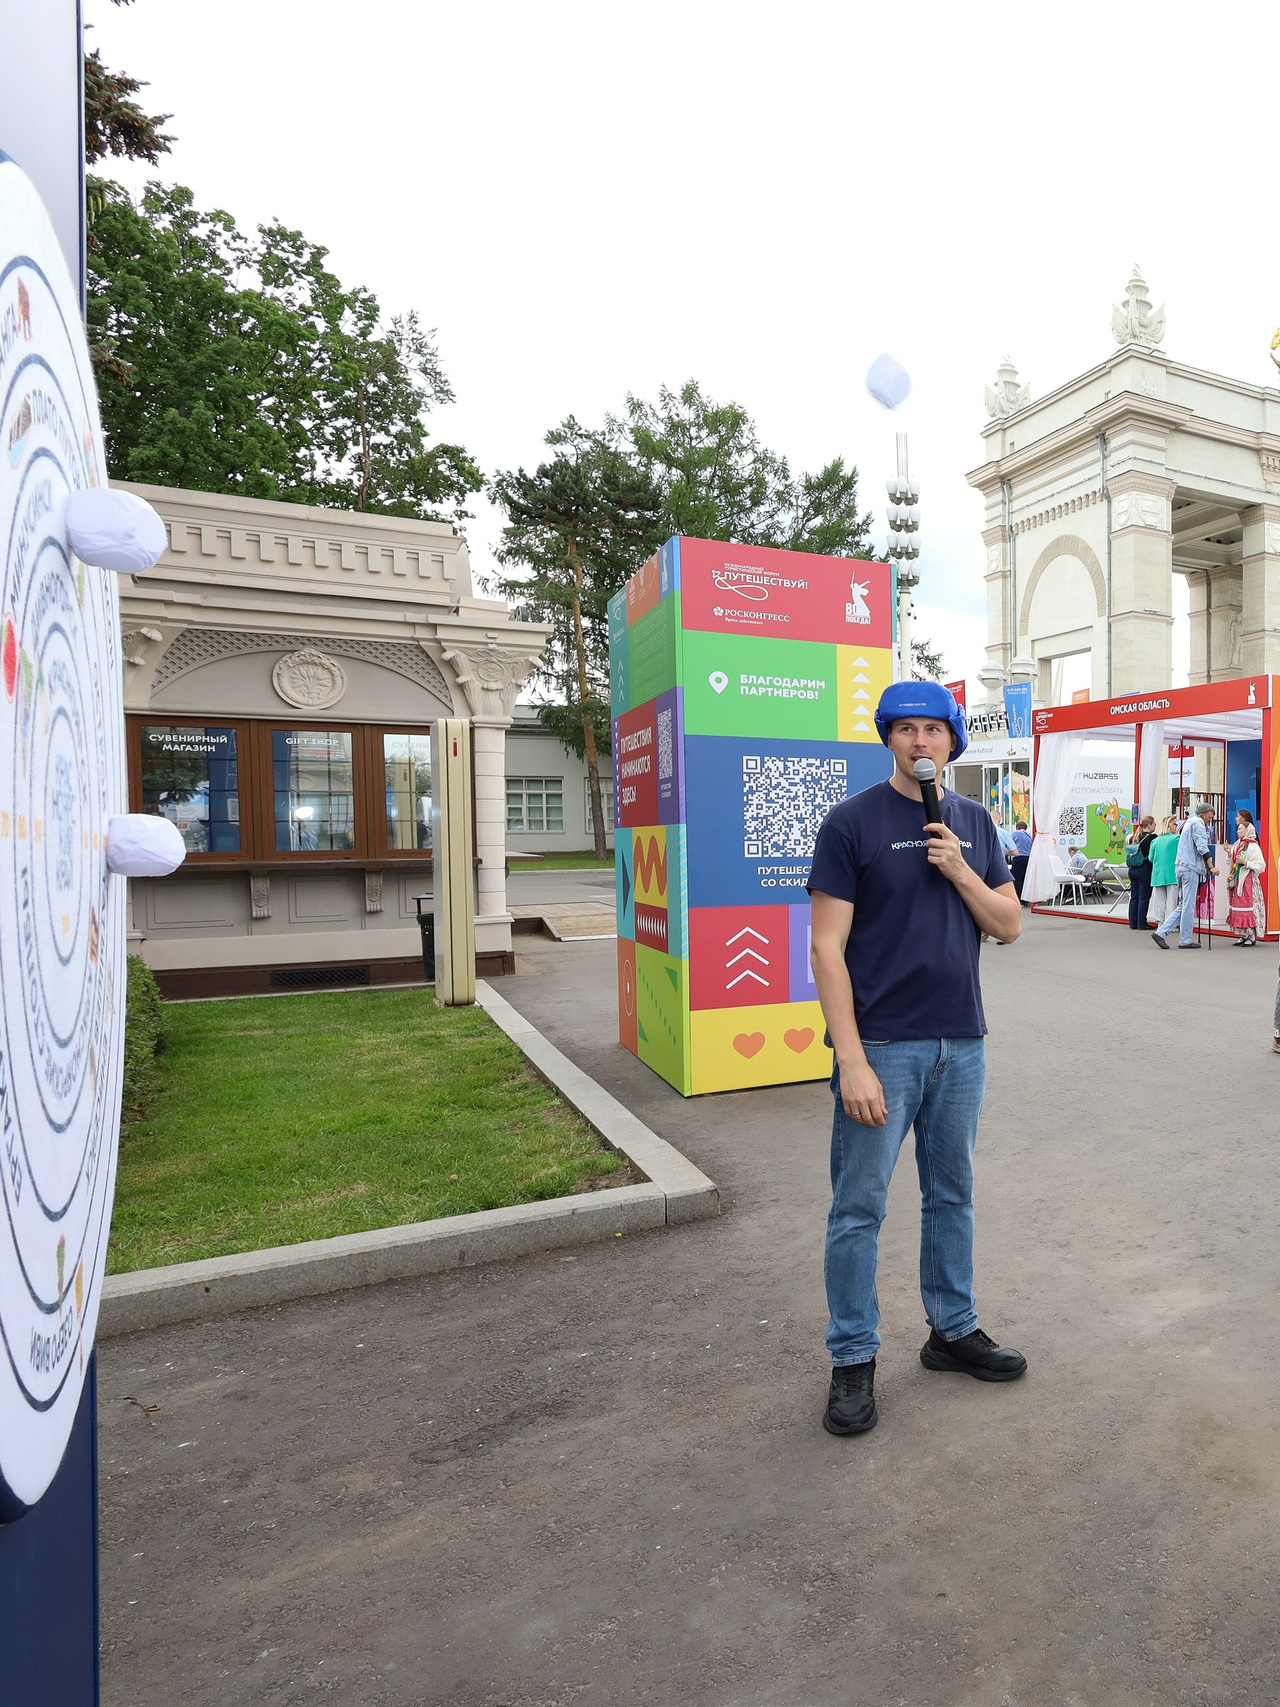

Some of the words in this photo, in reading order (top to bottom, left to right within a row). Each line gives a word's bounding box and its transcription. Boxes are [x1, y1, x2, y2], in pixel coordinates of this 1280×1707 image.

[724, 572, 809, 590] ПУТЕШЕСТВУЙ!
[725, 608, 791, 623] РОСКОНГРЕСС
[845, 616, 872, 625] ПОБЕДА!
[740, 674, 826, 690] БЛАГОДАРИМ
[740, 686, 819, 700] ПАРТНЕРОВ!
[1110, 703, 1137, 715] ОМСКАЯ
[1138, 699, 1170, 712] ОБЛАСТЬ
[966, 712, 1008, 734] ZBASS
[149, 733, 228, 744] СУВЕНИРНЫЙ
[310, 738, 339, 746] SHOP
[621, 726, 652, 754] ПУТЕШЕСТВИЯ
[162, 744, 216, 752] МАГАЗИН
[392, 741, 430, 749] СУВЕНИ
[891, 840, 927, 850] КРАСНОЯ
[959, 840, 973, 849] РАЙ
[757, 866, 812, 875] ПУТЕШЕС
[761, 879, 776, 887] СО
[779, 878, 808, 888] СКИД
[51, 1306, 72, 1370] ОЗЕРО
